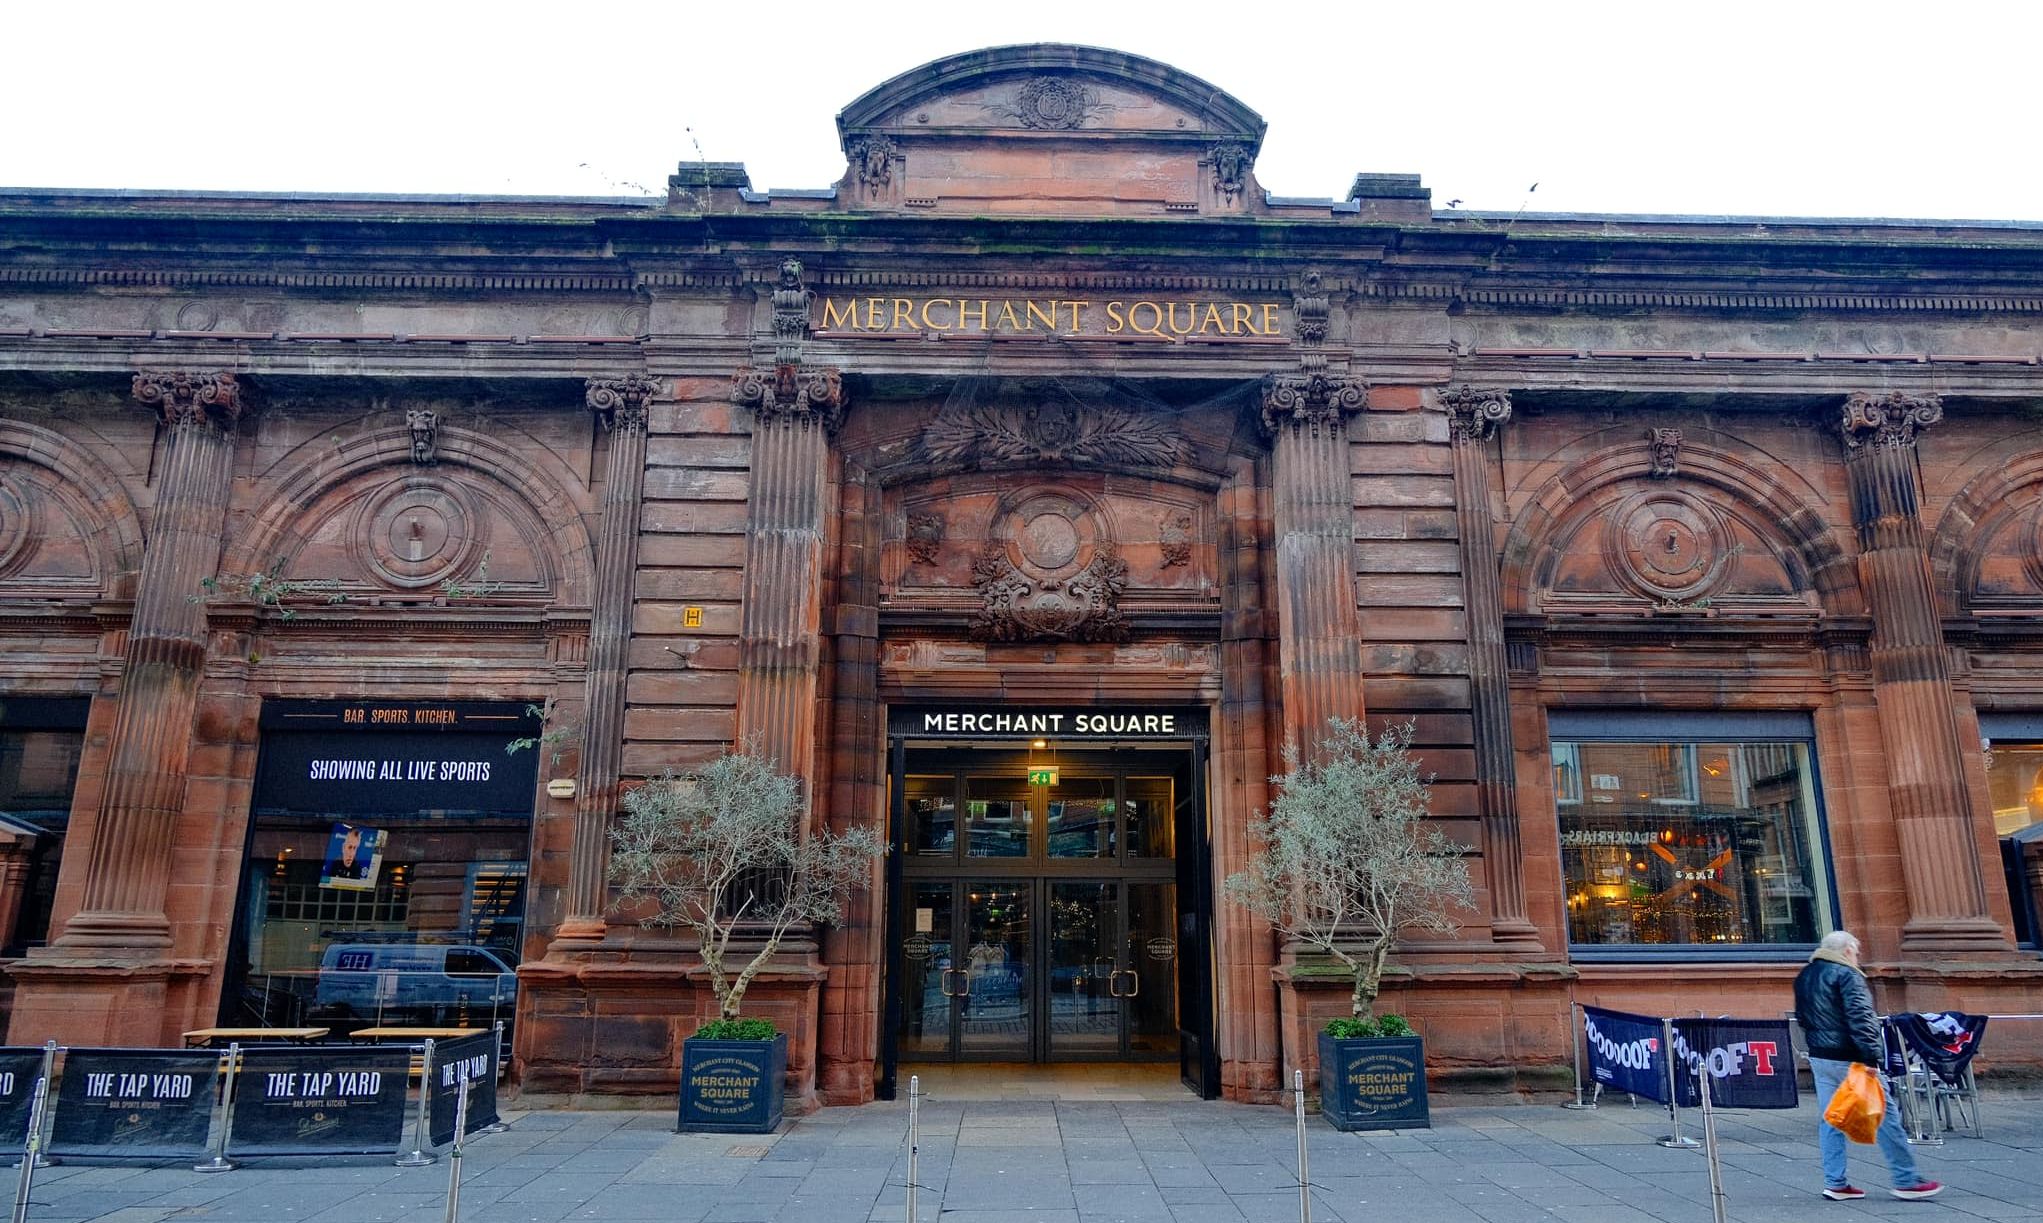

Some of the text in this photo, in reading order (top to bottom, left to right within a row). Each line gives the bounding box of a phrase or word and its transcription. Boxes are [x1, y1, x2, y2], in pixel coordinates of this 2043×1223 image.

[820, 297, 1281, 342] MERCHANT SQUARE
[686, 610, 700, 625] H
[344, 709, 458, 724] BAR. SPORTS. KITCHEN.
[924, 713, 1175, 733] MERCHANT SQUARE
[310, 760, 491, 781] SHOWING ALL LIVE SPORTS
[442, 1054, 488, 1087] THE TAP YARD
[1348, 1072, 1415, 1084] MERCHANT
[87, 1073, 193, 1098] THE TAP YARD
[267, 1071, 381, 1096] THE TAP YARD
[691, 1076, 760, 1088] MERCHANT
[1359, 1084, 1408, 1095] SQUARE
[700, 1088, 750, 1099] SQUARE
